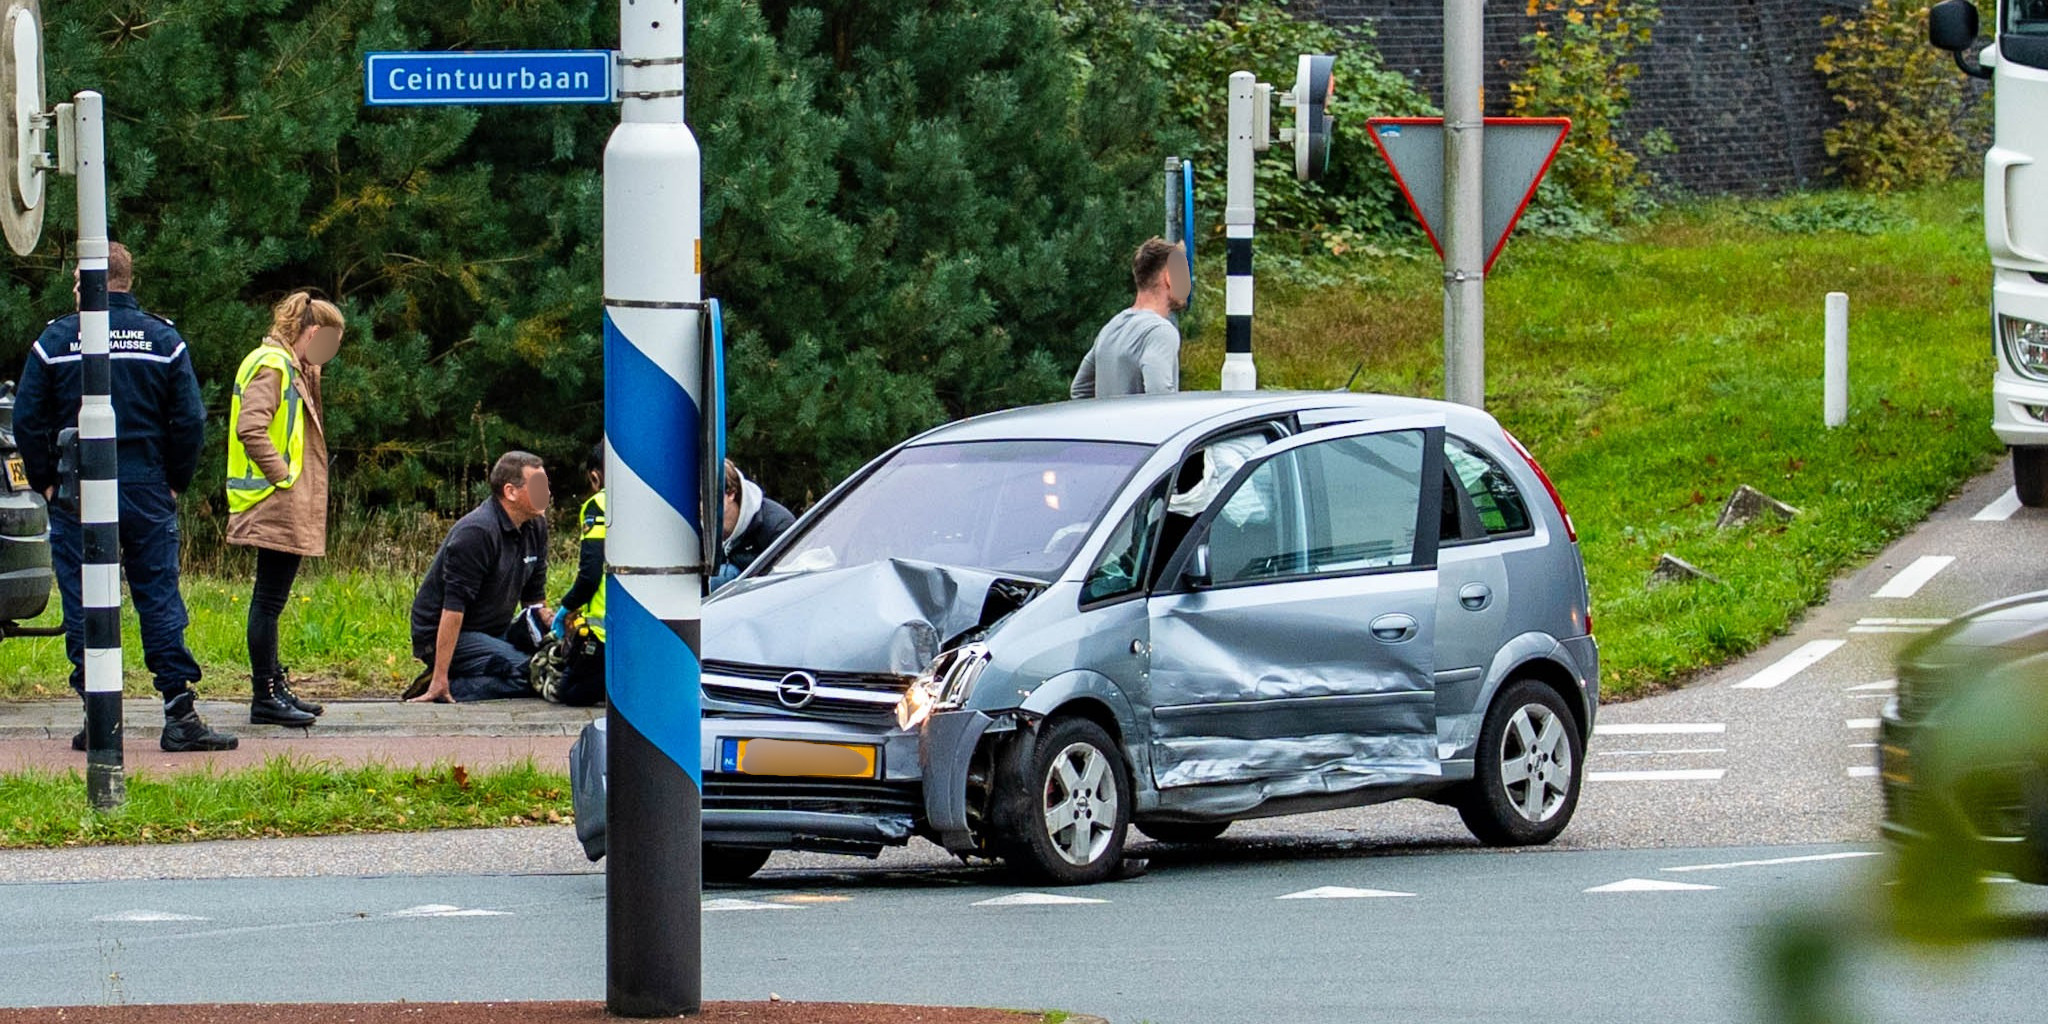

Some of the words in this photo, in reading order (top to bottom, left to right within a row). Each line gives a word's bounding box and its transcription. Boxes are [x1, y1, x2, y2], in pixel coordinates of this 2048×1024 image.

[389, 67, 589, 91] Ceintuurbaan
[78, 330, 144, 340] KLIJKE
[70, 340, 152, 351] MAAUSSEE
[724, 758, 735, 766] NL
